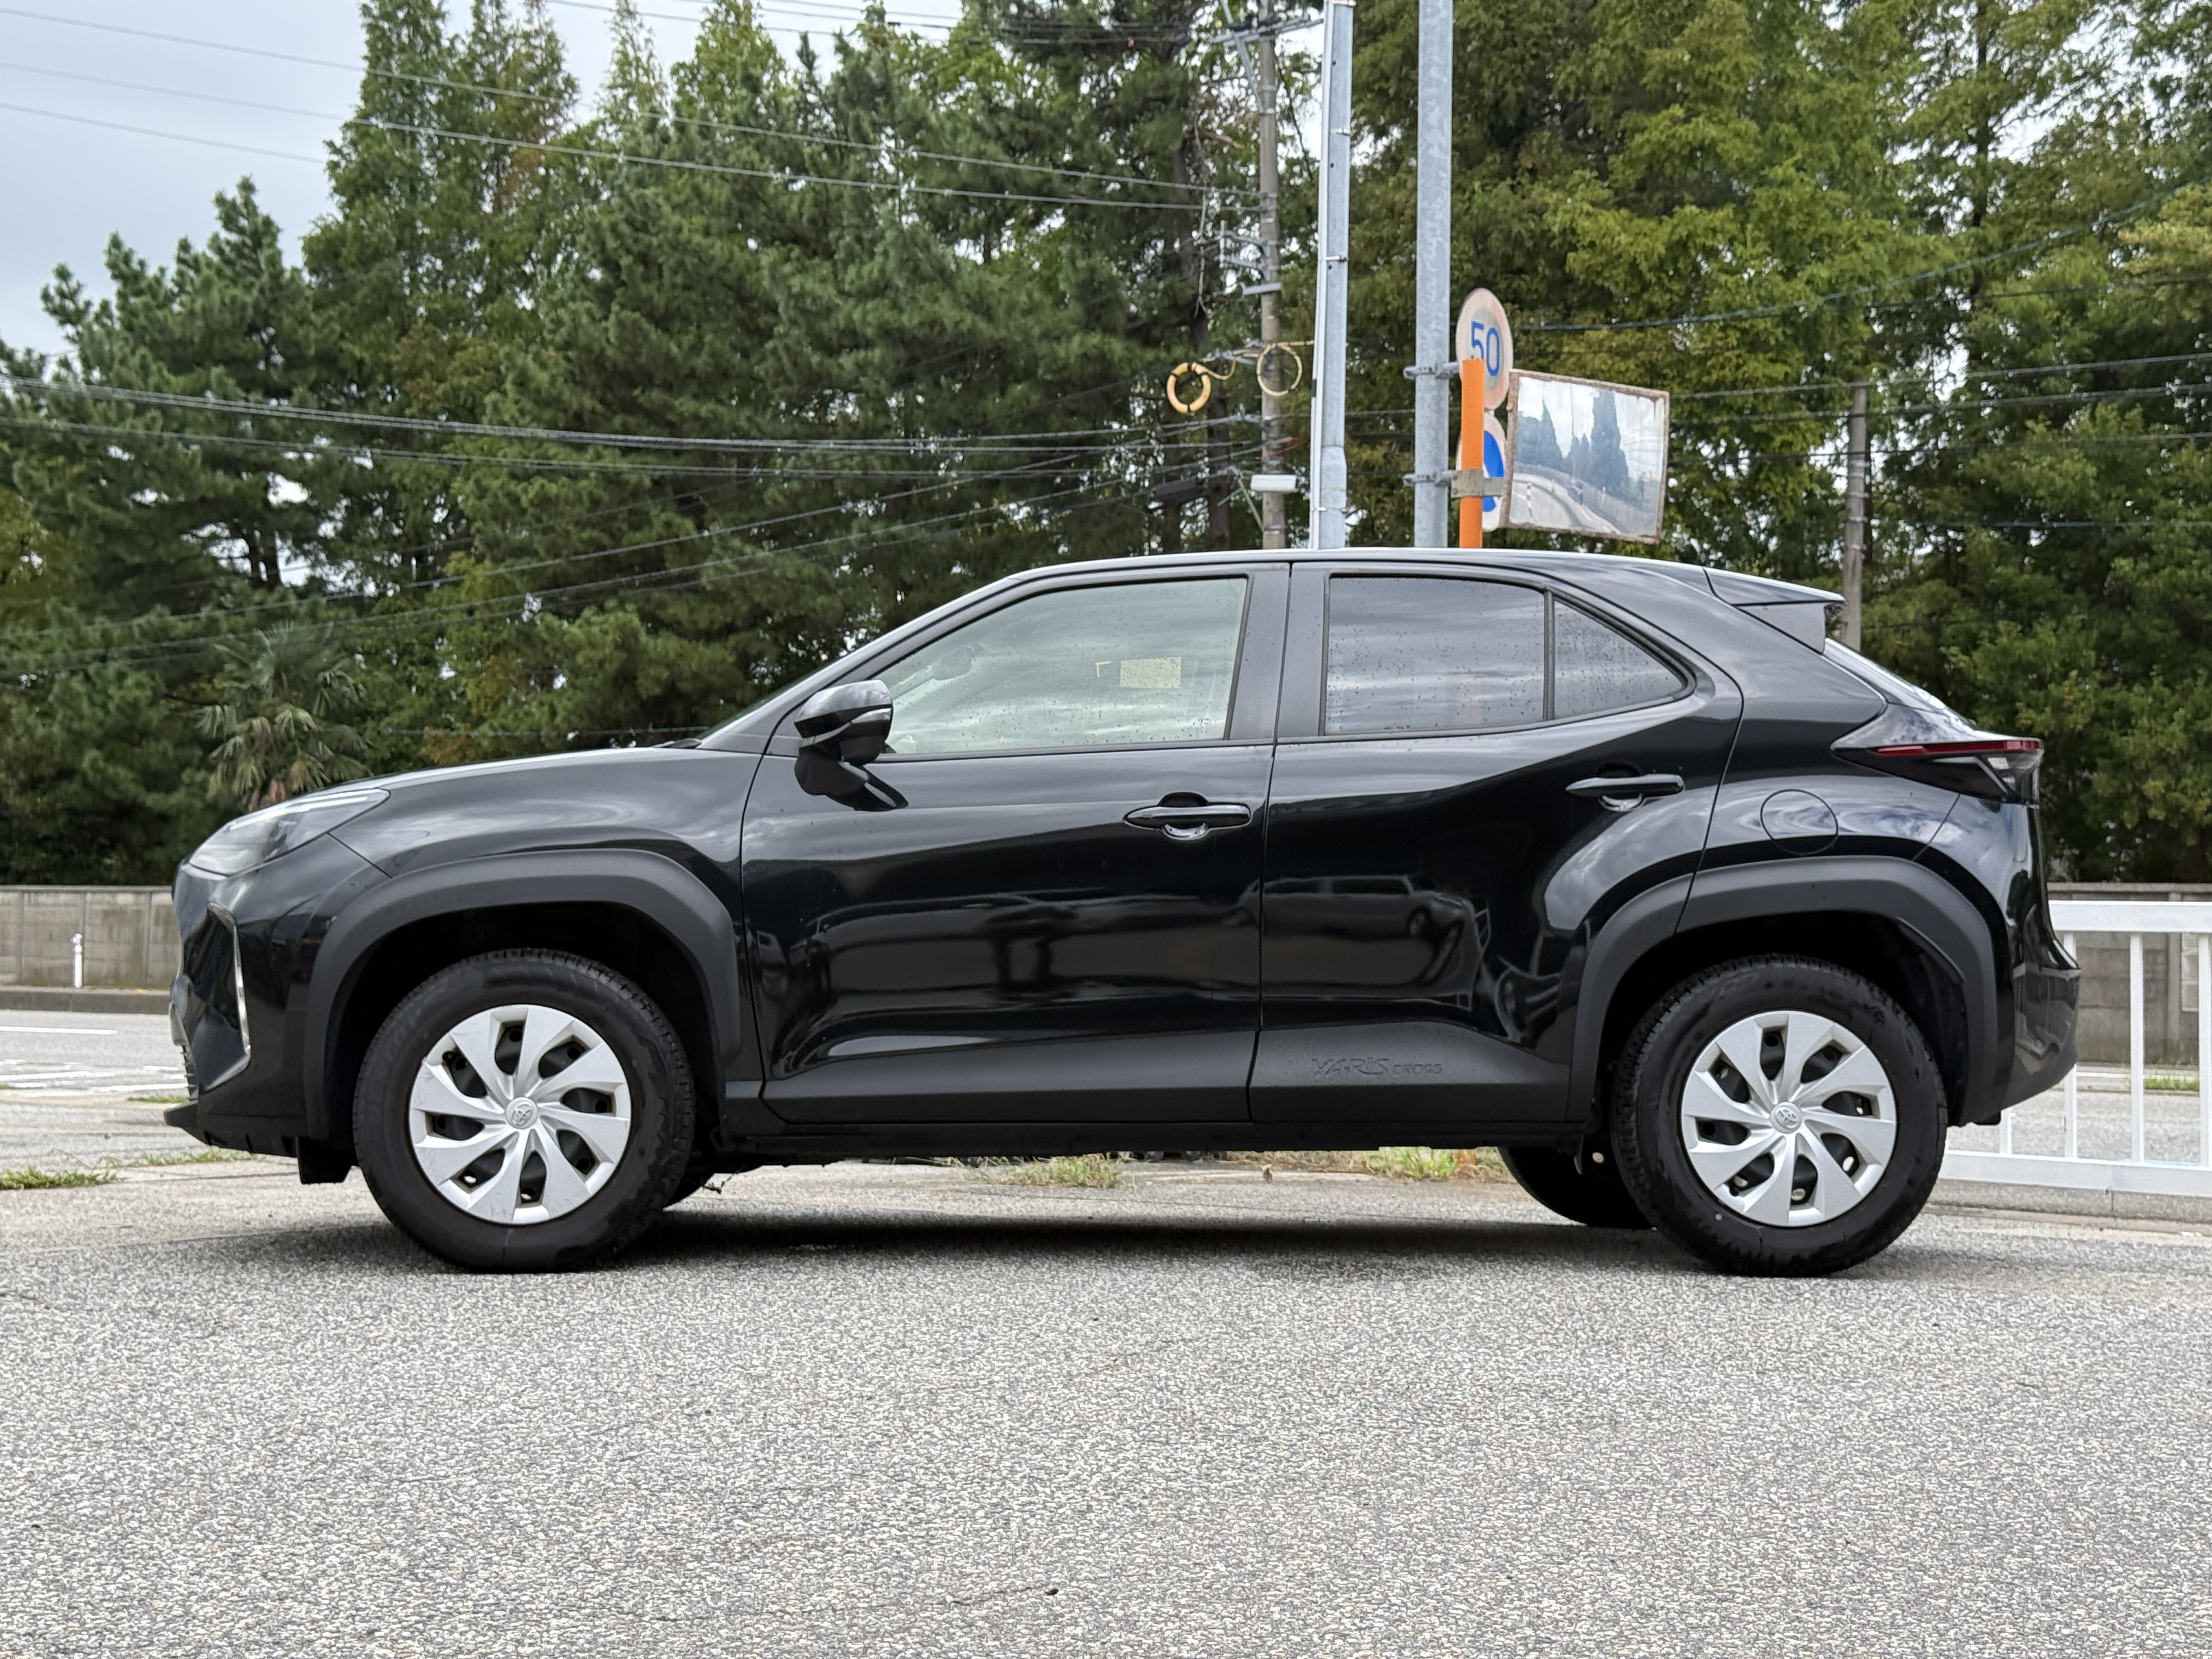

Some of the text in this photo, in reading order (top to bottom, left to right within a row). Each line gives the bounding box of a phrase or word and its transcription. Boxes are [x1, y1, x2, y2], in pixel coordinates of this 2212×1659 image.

[1471, 321, 1500, 376] 50
[1312, 1057, 1442, 1075] YARIS CROSS
